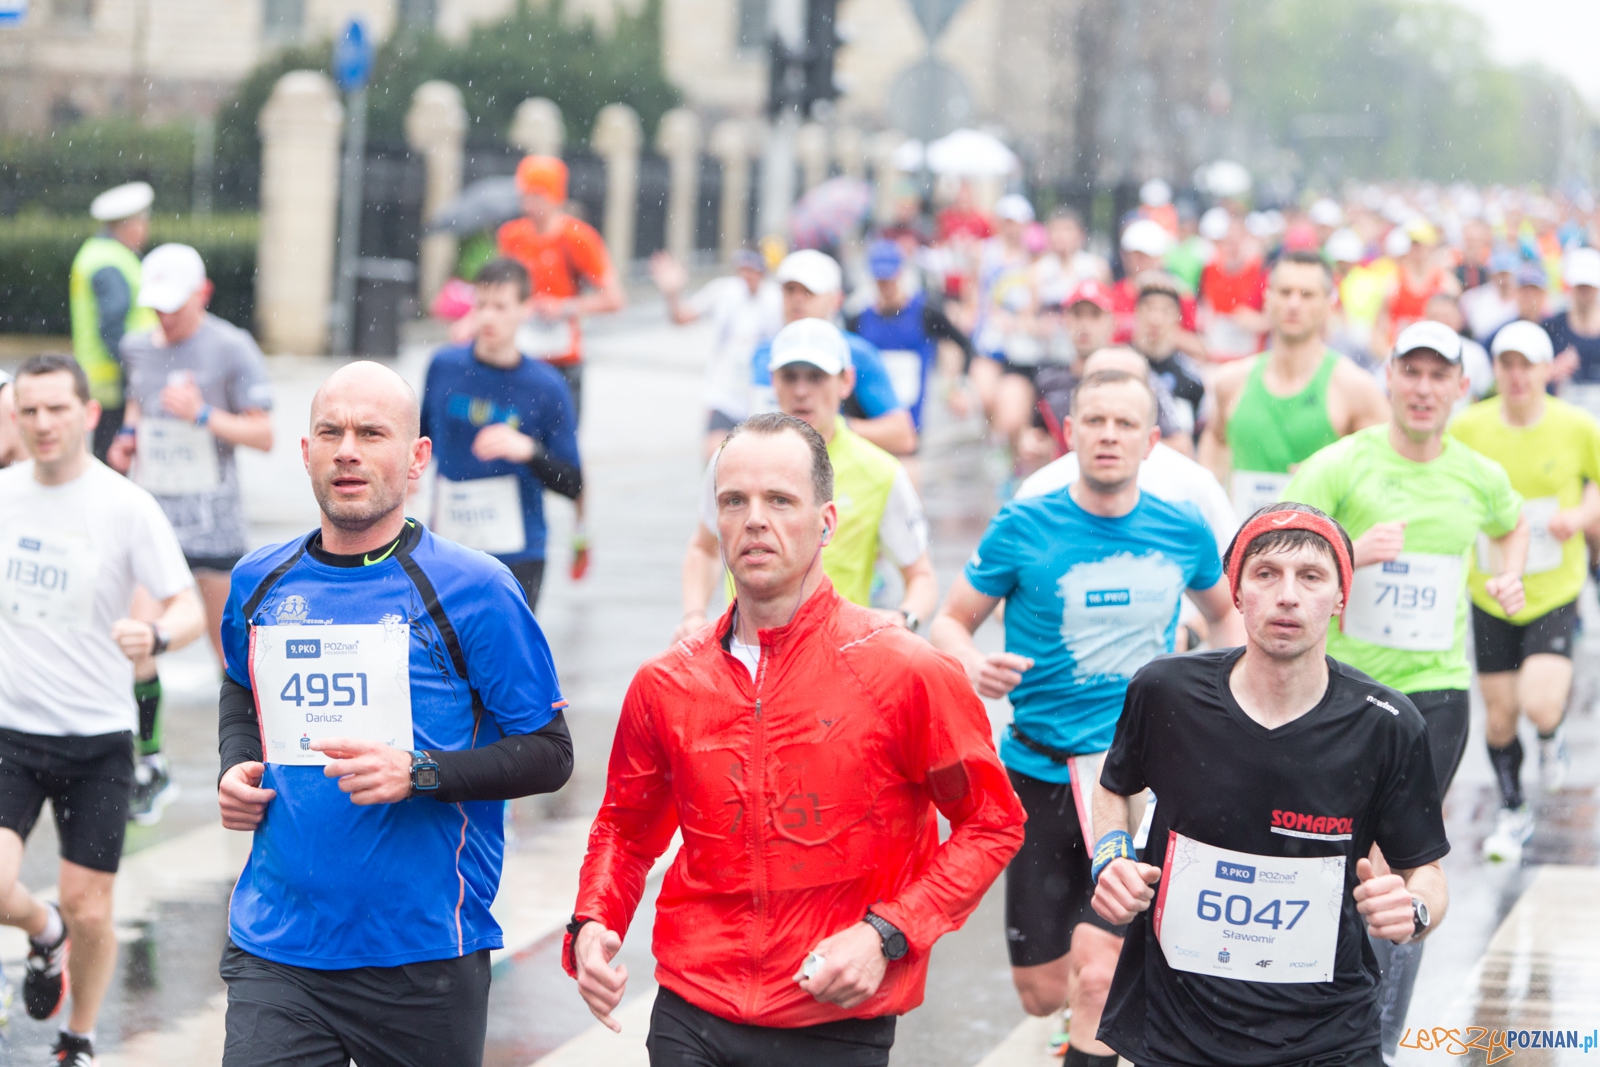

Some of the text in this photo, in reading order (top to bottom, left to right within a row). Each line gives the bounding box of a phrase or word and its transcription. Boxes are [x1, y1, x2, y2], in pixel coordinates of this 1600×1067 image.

[6, 557, 68, 592] 11301
[1374, 581, 1437, 611] 7139
[280, 672, 368, 707] 4951
[305, 713, 343, 723] Dariusz
[1366, 694, 1400, 716] newline
[1270, 809, 1354, 834] SOMAPOL
[1197, 889, 1310, 931] 6047
[1222, 929, 1276, 944] Sławomir
